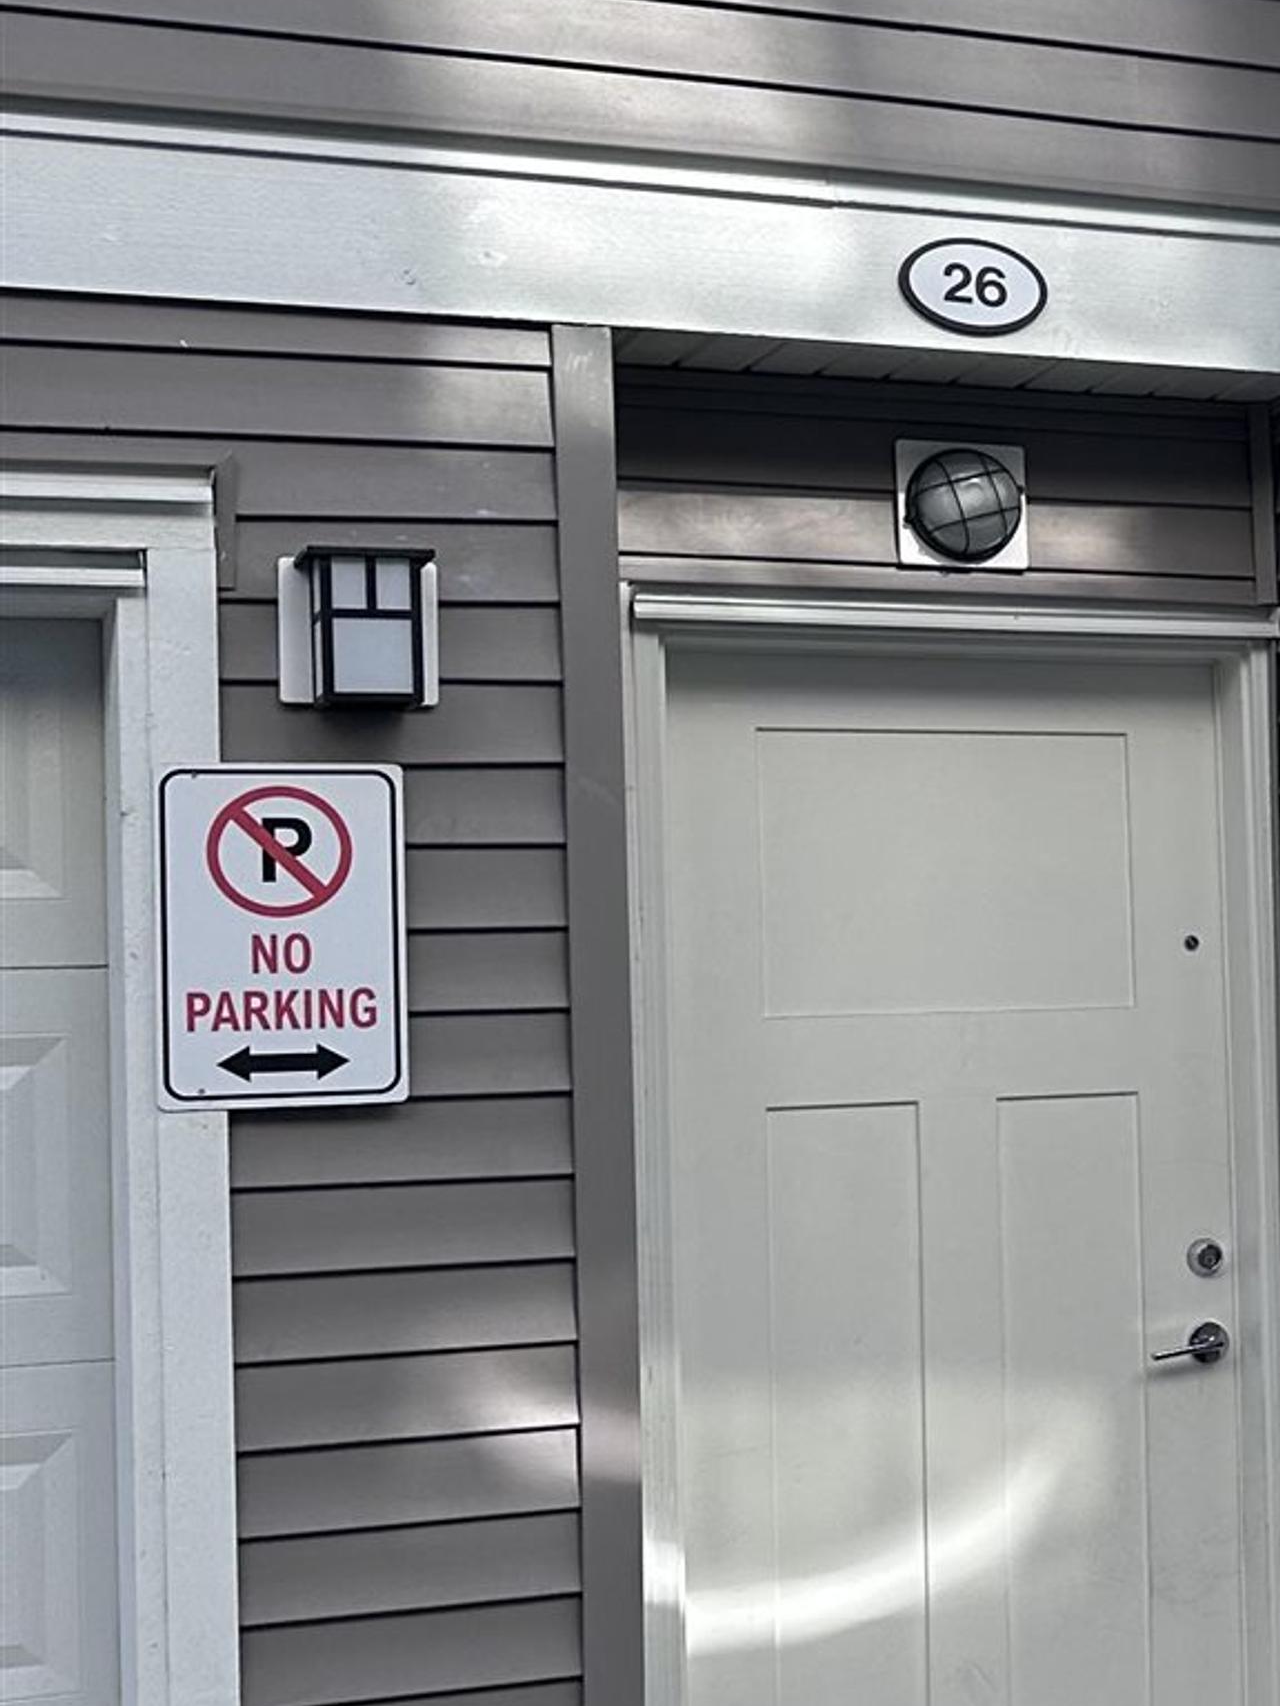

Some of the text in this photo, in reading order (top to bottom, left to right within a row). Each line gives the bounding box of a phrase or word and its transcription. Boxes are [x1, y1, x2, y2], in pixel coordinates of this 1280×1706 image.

[943, 262, 1008, 307] 26
[262, 817, 313, 883] P
[251, 933, 312, 975] NO
[185, 988, 378, 1032] PARKING
